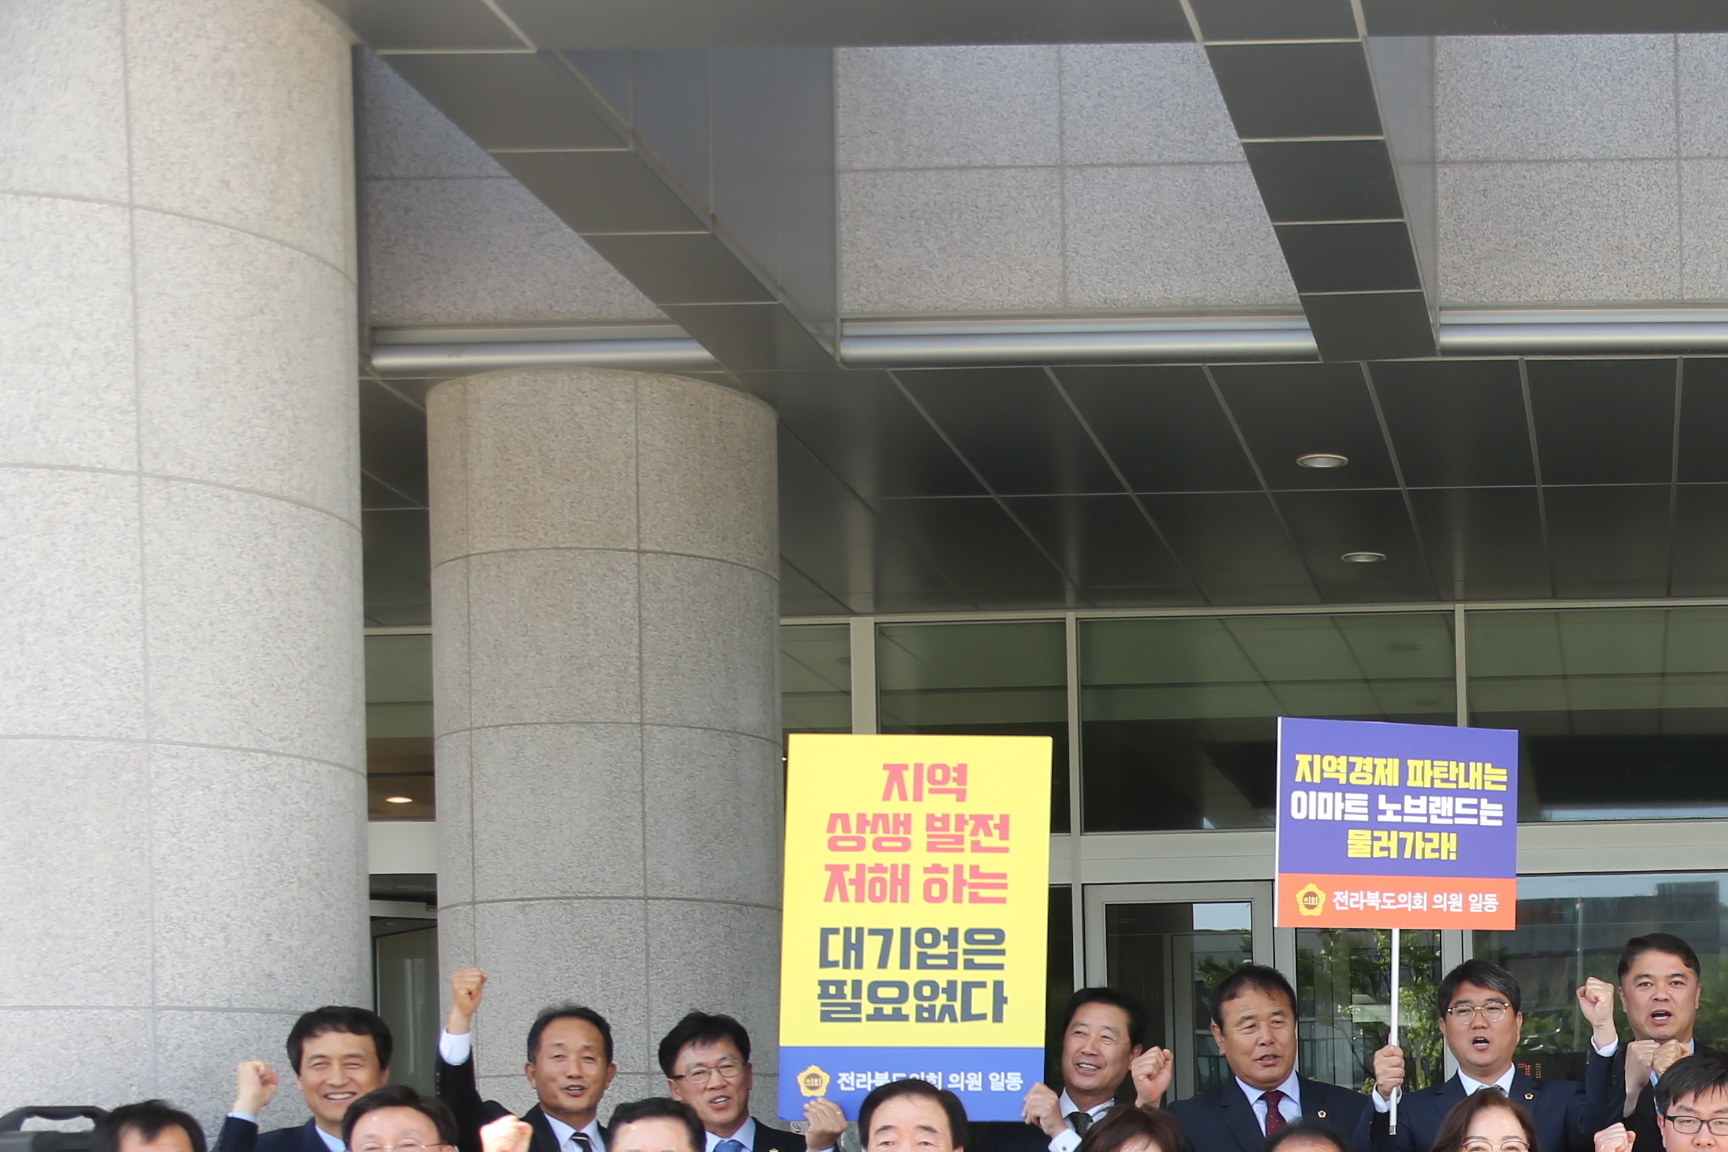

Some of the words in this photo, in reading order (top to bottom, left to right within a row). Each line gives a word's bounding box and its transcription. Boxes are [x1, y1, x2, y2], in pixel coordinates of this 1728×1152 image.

[881, 763, 968, 802] 지역
[1295, 754, 1400, 786] 지역경제
[1407, 759, 1508, 791] 파탄내는
[1291, 791, 1369, 821] 이마트
[1377, 794, 1503, 826] 노브랜드는
[826, 813, 912, 853] 상생
[925, 813, 1010, 853] 발전
[1347, 829, 1457, 860] 물러가라!
[823, 863, 911, 903] 저해
[922, 863, 1008, 904] 하는
[1304, 896, 1318, 906] 의회
[1333, 891, 1427, 911] 전라북도의회
[1432, 893, 1463, 912] 의원
[1468, 893, 1498, 913] 일동
[819, 927, 1006, 971] 대기업은
[817, 980, 1008, 1023] 필요없다
[948, 1072, 983, 1091] 의원
[989, 1072, 1023, 1091] 일동
